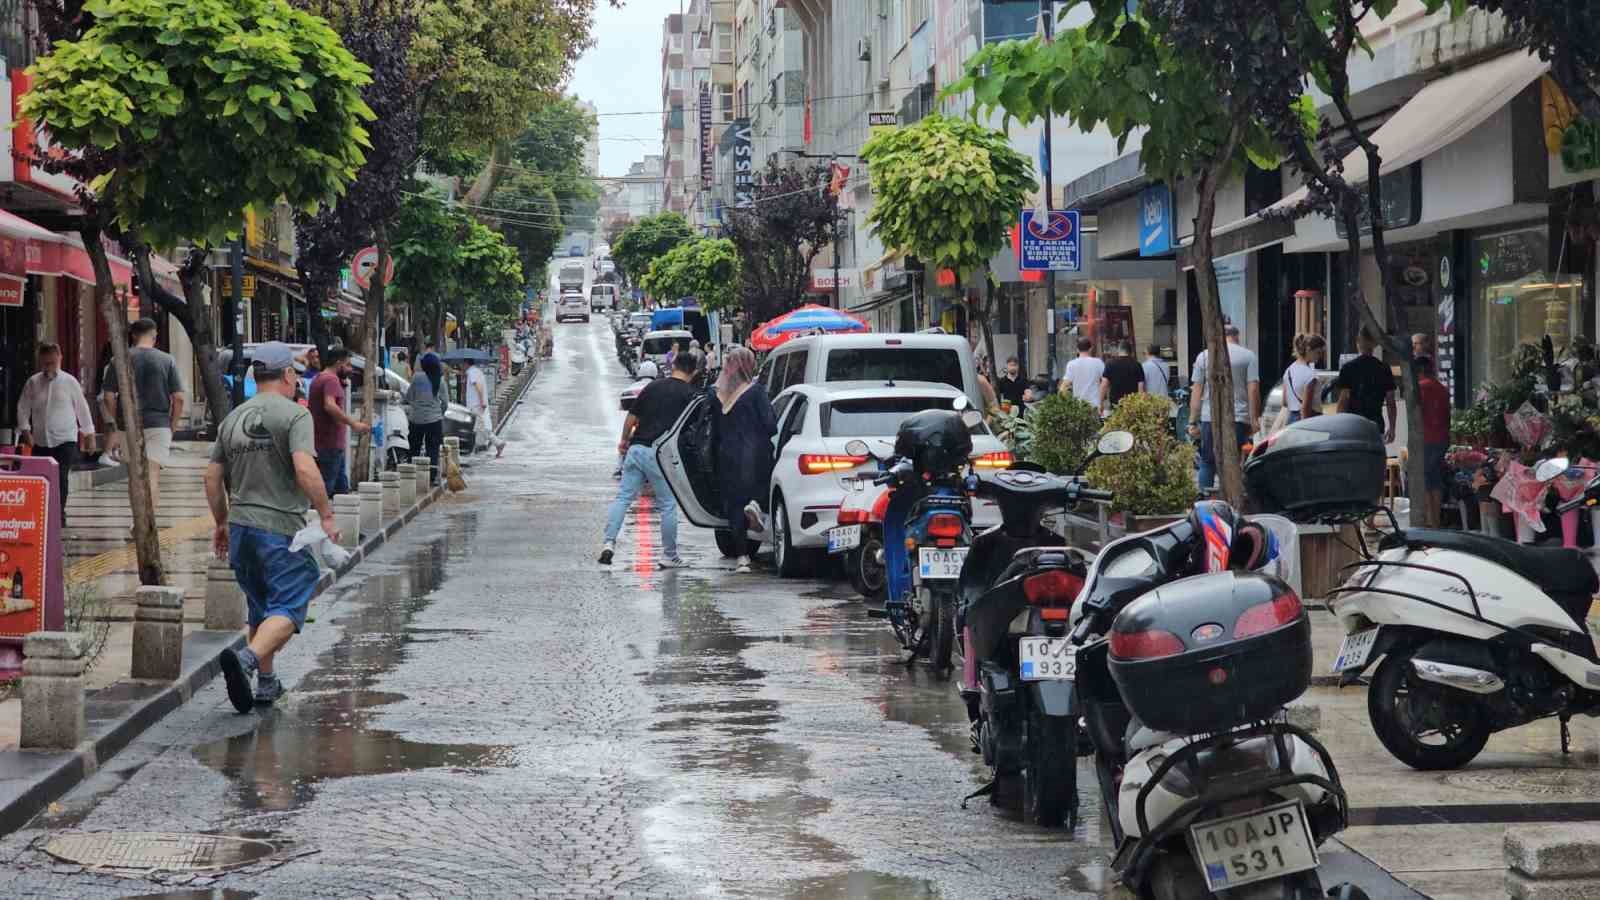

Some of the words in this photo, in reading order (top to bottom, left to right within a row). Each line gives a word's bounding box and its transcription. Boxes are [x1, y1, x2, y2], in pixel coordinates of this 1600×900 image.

[1039, 661, 1074, 675] 932
[1206, 812, 1294, 851] 10AJP
[1231, 845, 1285, 877] 531
